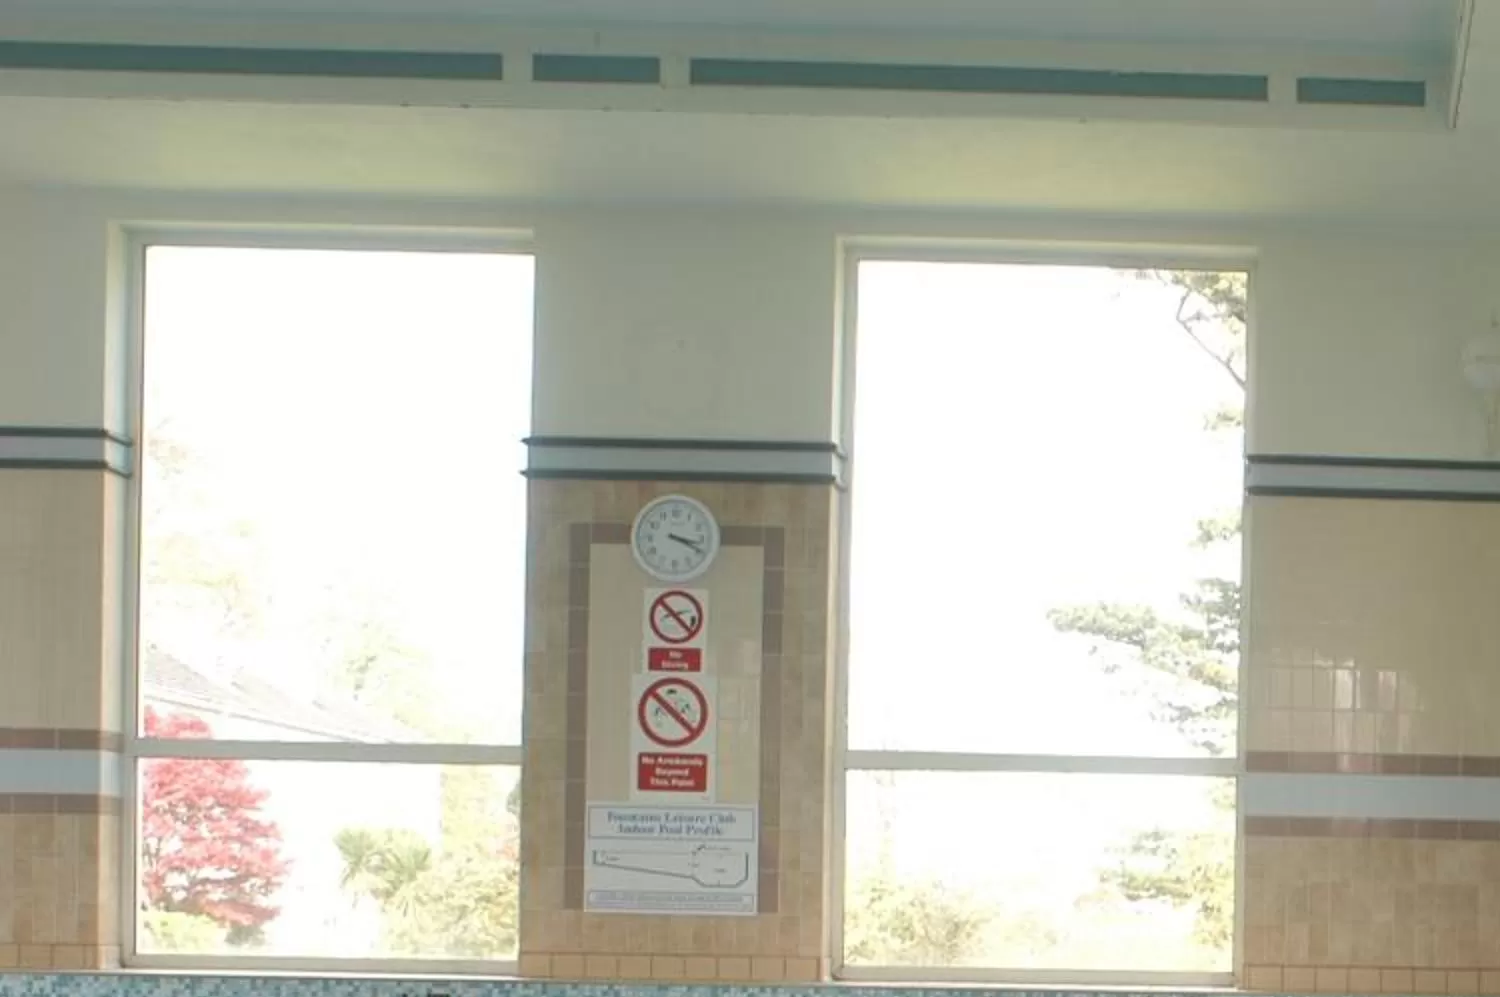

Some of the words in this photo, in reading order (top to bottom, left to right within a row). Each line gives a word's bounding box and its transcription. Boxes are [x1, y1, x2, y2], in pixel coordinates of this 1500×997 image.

[664, 812, 708, 825] Leisure
[709, 812, 737, 824] Club
[659, 824, 684, 834] Pool
